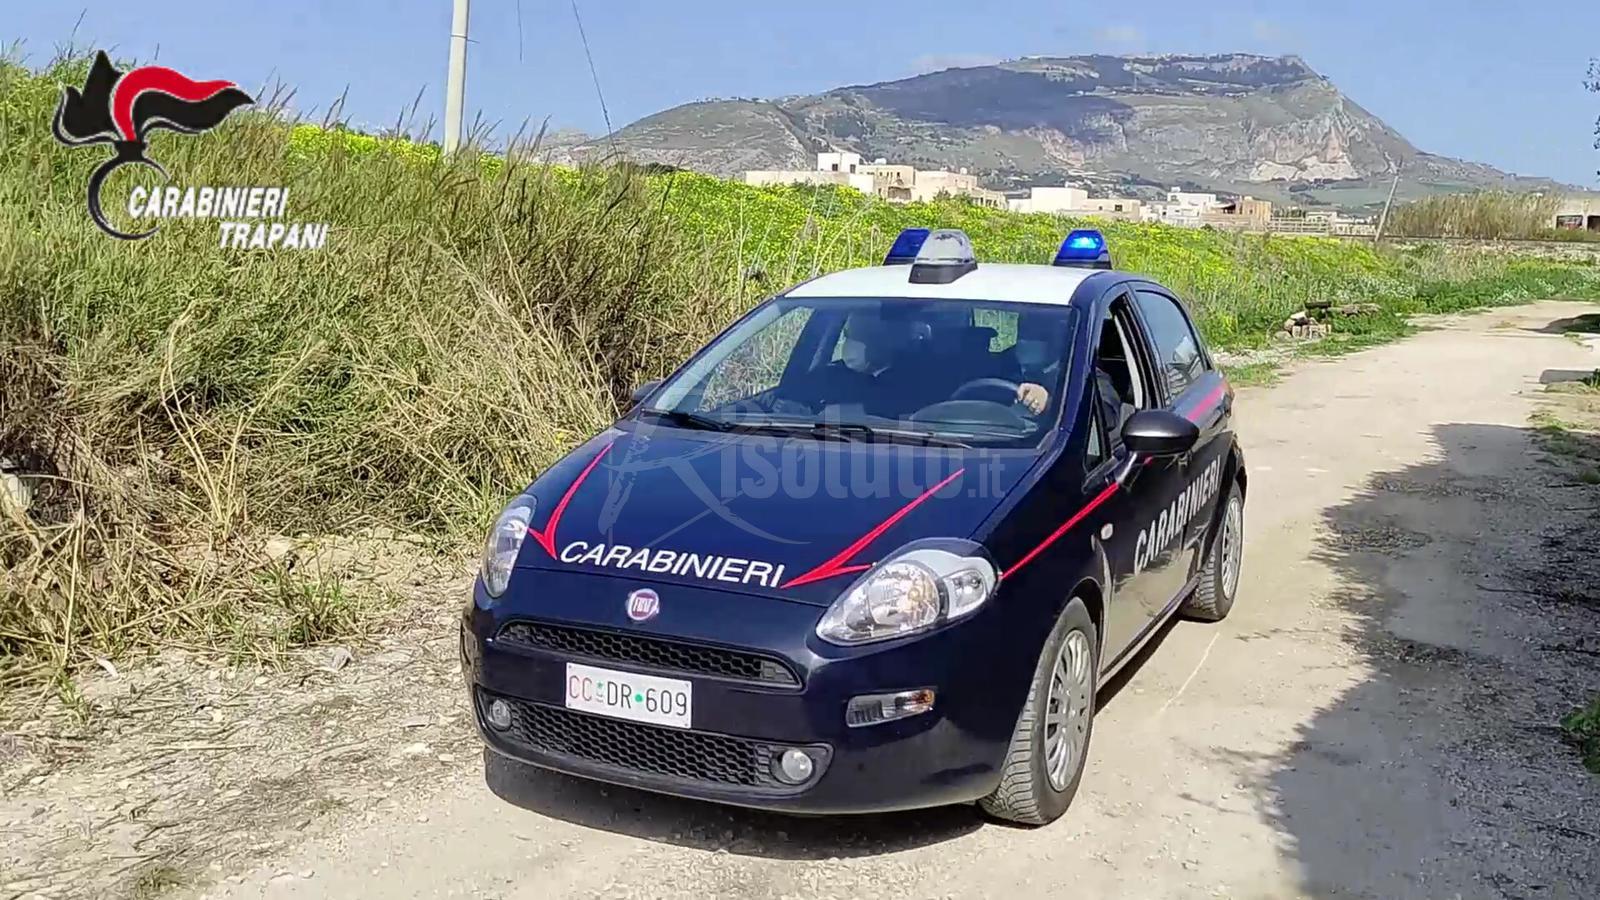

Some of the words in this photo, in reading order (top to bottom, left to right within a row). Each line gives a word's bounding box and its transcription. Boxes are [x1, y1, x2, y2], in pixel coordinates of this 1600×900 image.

[1134, 454, 1221, 575] CARABINIERI
[560, 541, 785, 588] CARABINIERI
[607, 681, 632, 710] DR
[646, 688, 688, 717] 609
